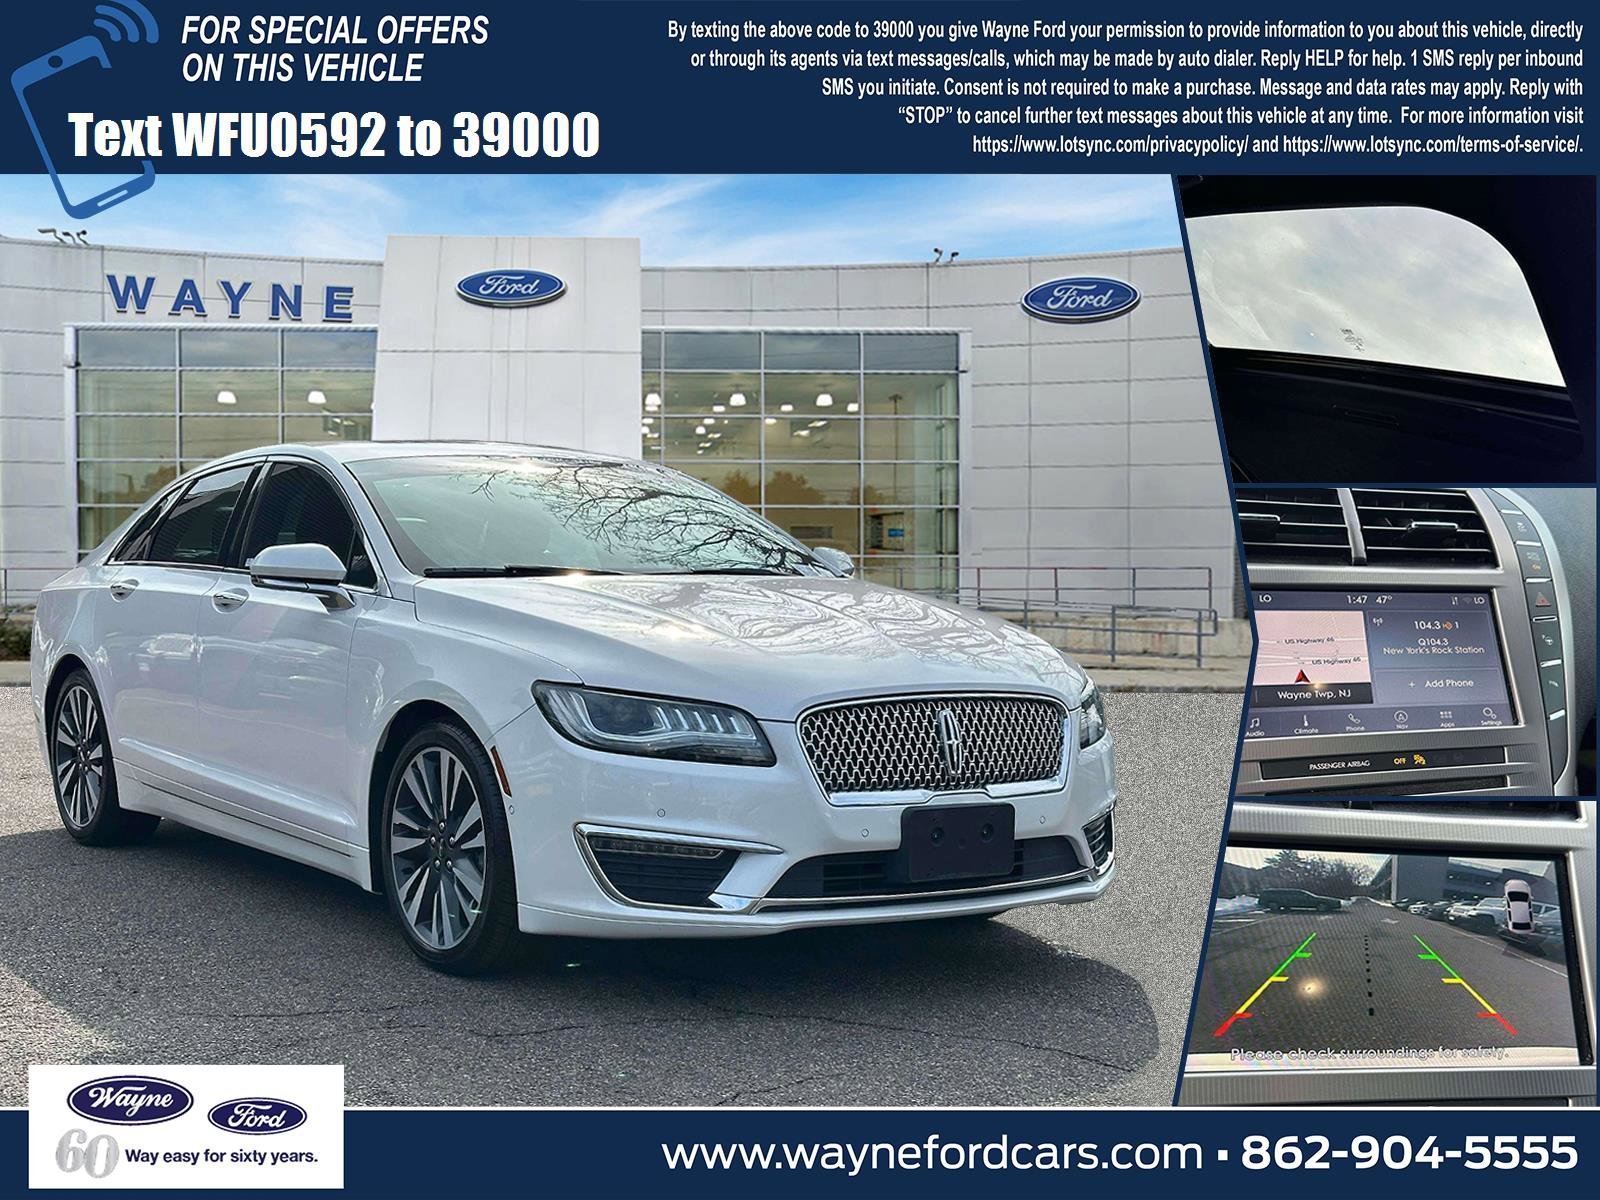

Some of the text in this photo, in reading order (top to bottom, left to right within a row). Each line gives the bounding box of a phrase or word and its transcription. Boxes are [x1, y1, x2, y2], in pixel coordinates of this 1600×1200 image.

[479, 275, 540, 295] Ford
[107, 274, 357, 322] WAYNE
[1047, 284, 1114, 309] Ford
[1347, 595, 1368, 604] 1:47
[1414, 621, 1441, 630] 104.3
[1418, 638, 1449, 646] Q104.3
[1383, 647, 1403, 655] New
[1455, 646, 1485, 654] Station
[1425, 680, 1444, 688] Add
[1277, 690, 1312, 701] Wayne
[1339, 689, 1352, 698] NJ
[1394, 757, 1406, 765] OFF
[1309, 762, 1346, 771] PASSENGER
[1231, 1046, 1509, 1061] Please check surroundings for safety.
